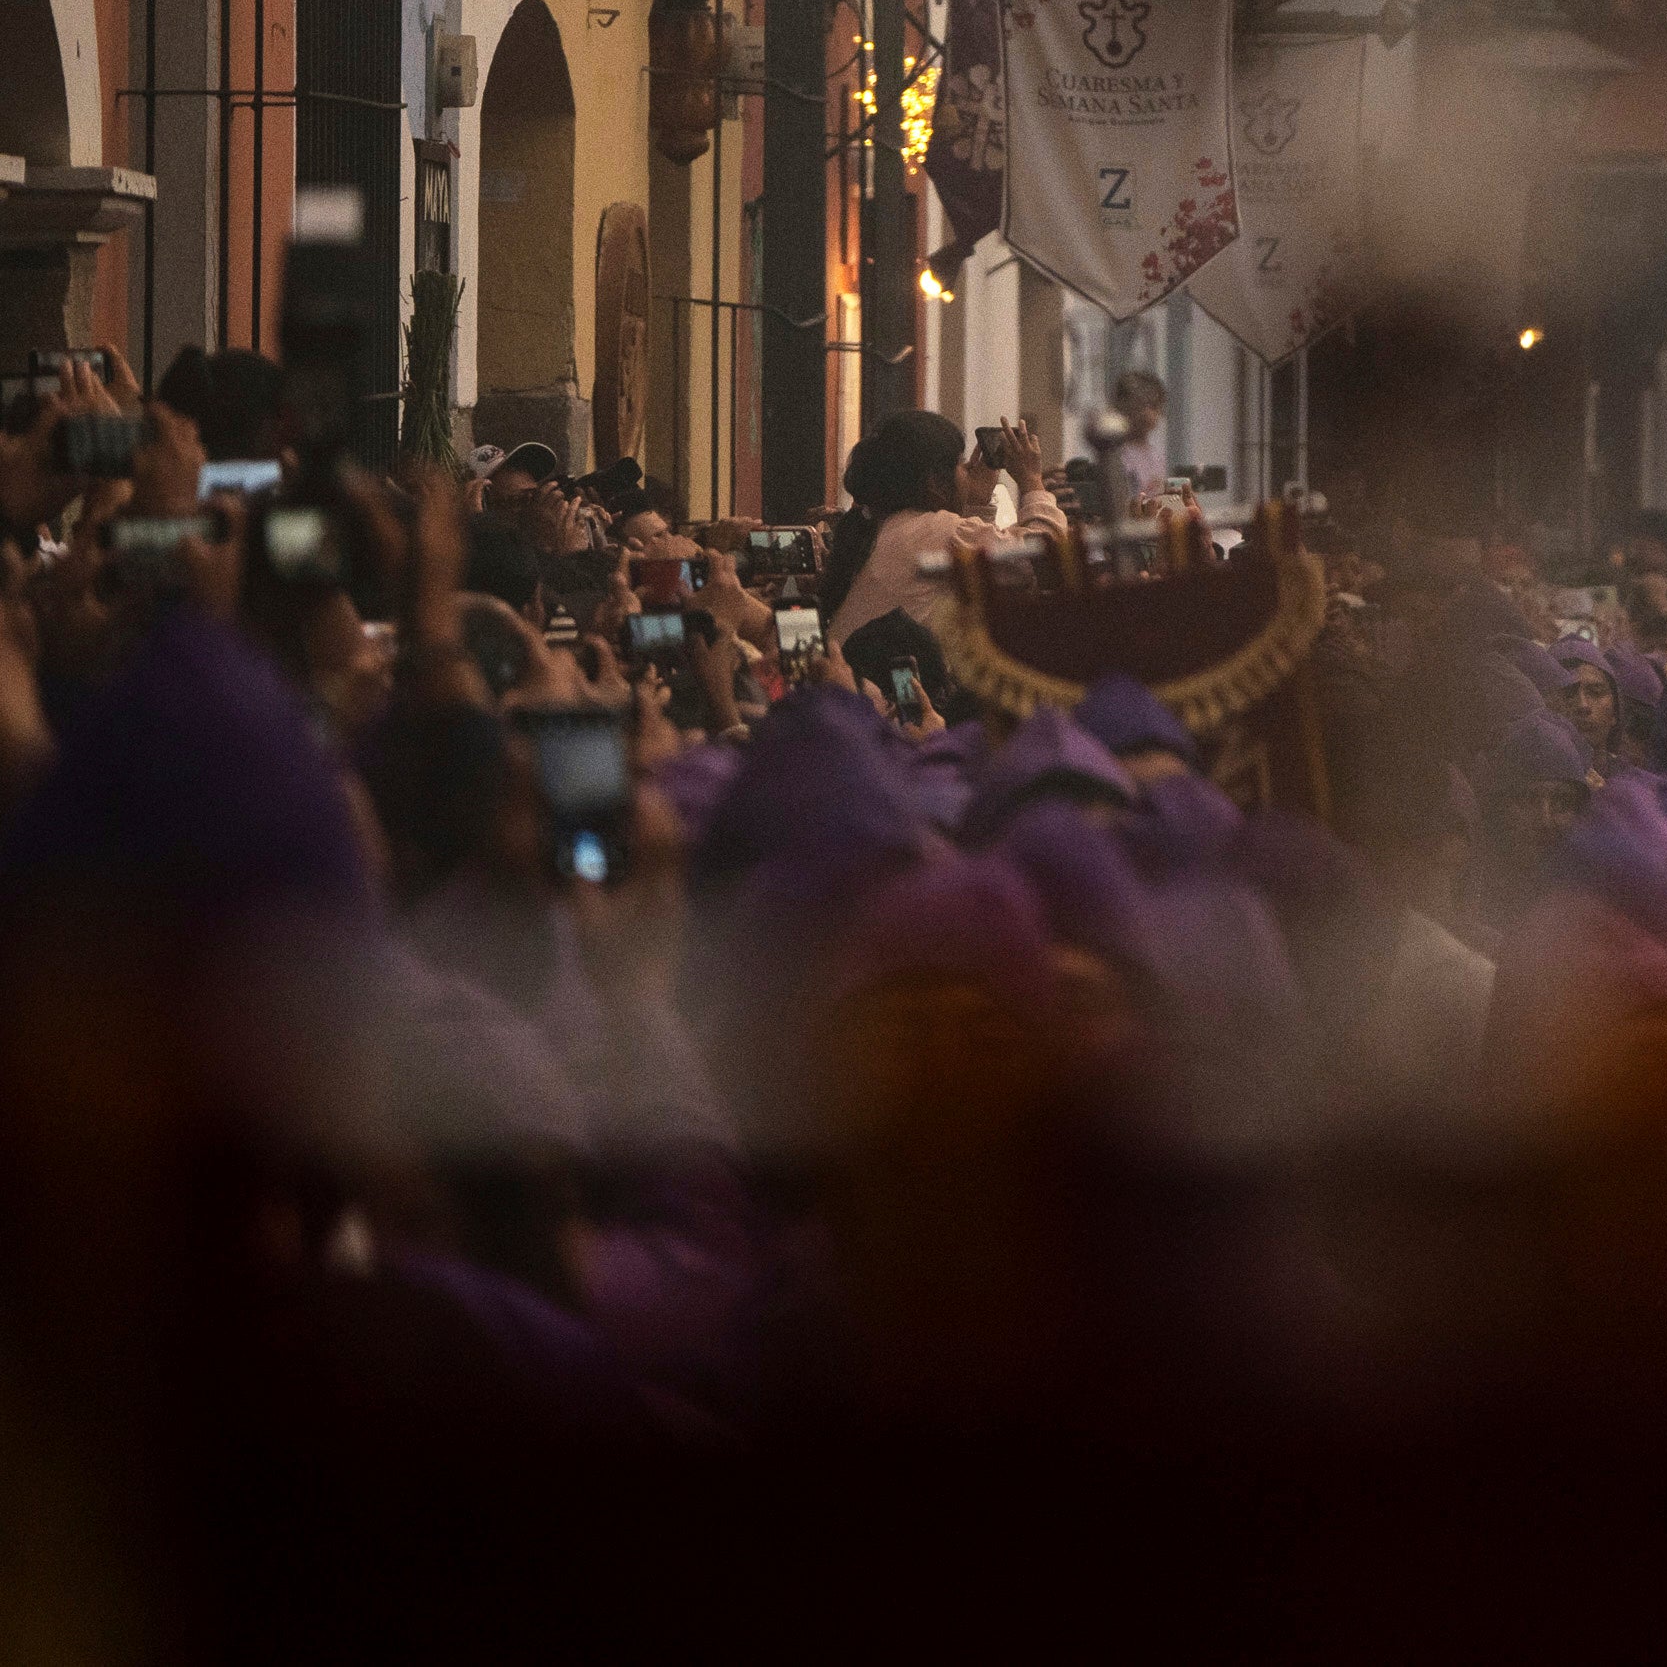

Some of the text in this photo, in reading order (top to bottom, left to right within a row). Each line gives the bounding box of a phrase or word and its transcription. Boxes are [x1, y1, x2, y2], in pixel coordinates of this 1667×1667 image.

[1045, 68, 1167, 92] CUARESMA
[1127, 92, 1200, 115] SANTA
[1098, 167, 1132, 210] Z
[1256, 236, 1282, 273] Z
